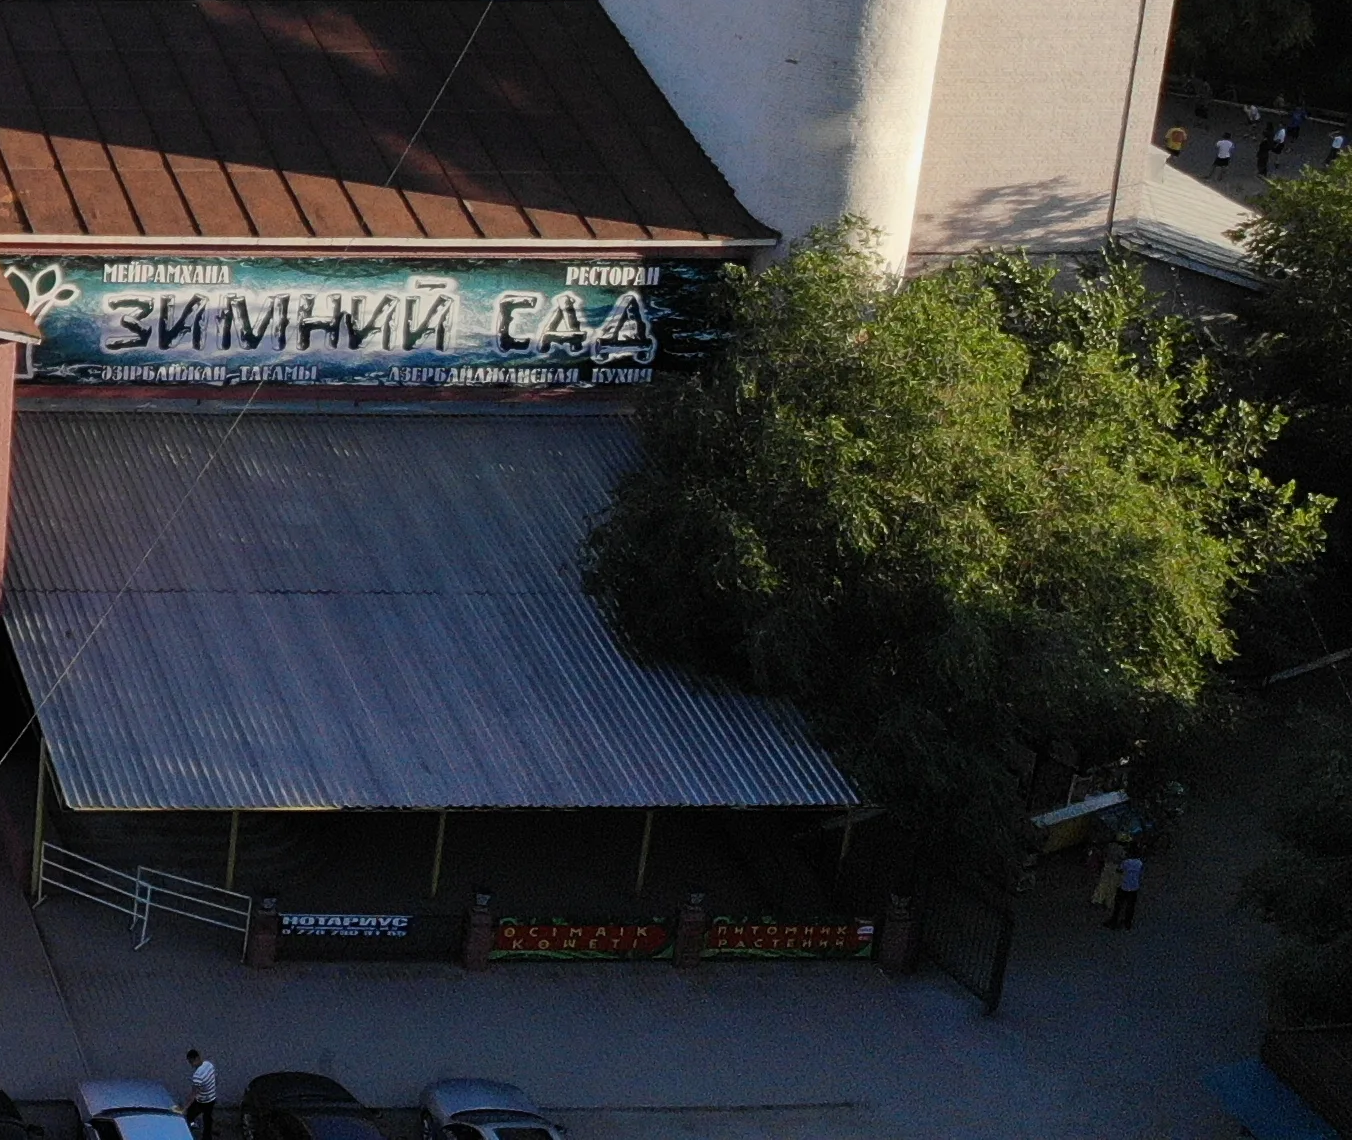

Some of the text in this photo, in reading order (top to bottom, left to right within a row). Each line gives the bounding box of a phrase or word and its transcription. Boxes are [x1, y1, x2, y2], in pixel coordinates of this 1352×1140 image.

[103, 261, 231, 285] МЕЙРАМХАНА
[565, 266, 661, 286] РЕСТОРАН
[104, 278, 655, 362] ЗИМНИЙ САД
[388, 364, 654, 384] АЗЕРБАЙДЖАНСКАЯ КУХНЯ
[281, 915, 409, 928] НОТАРИУС
[717, 926, 848, 936] ПИТОМНИК
[717, 936, 845, 949] РАСТЕНИЙ
